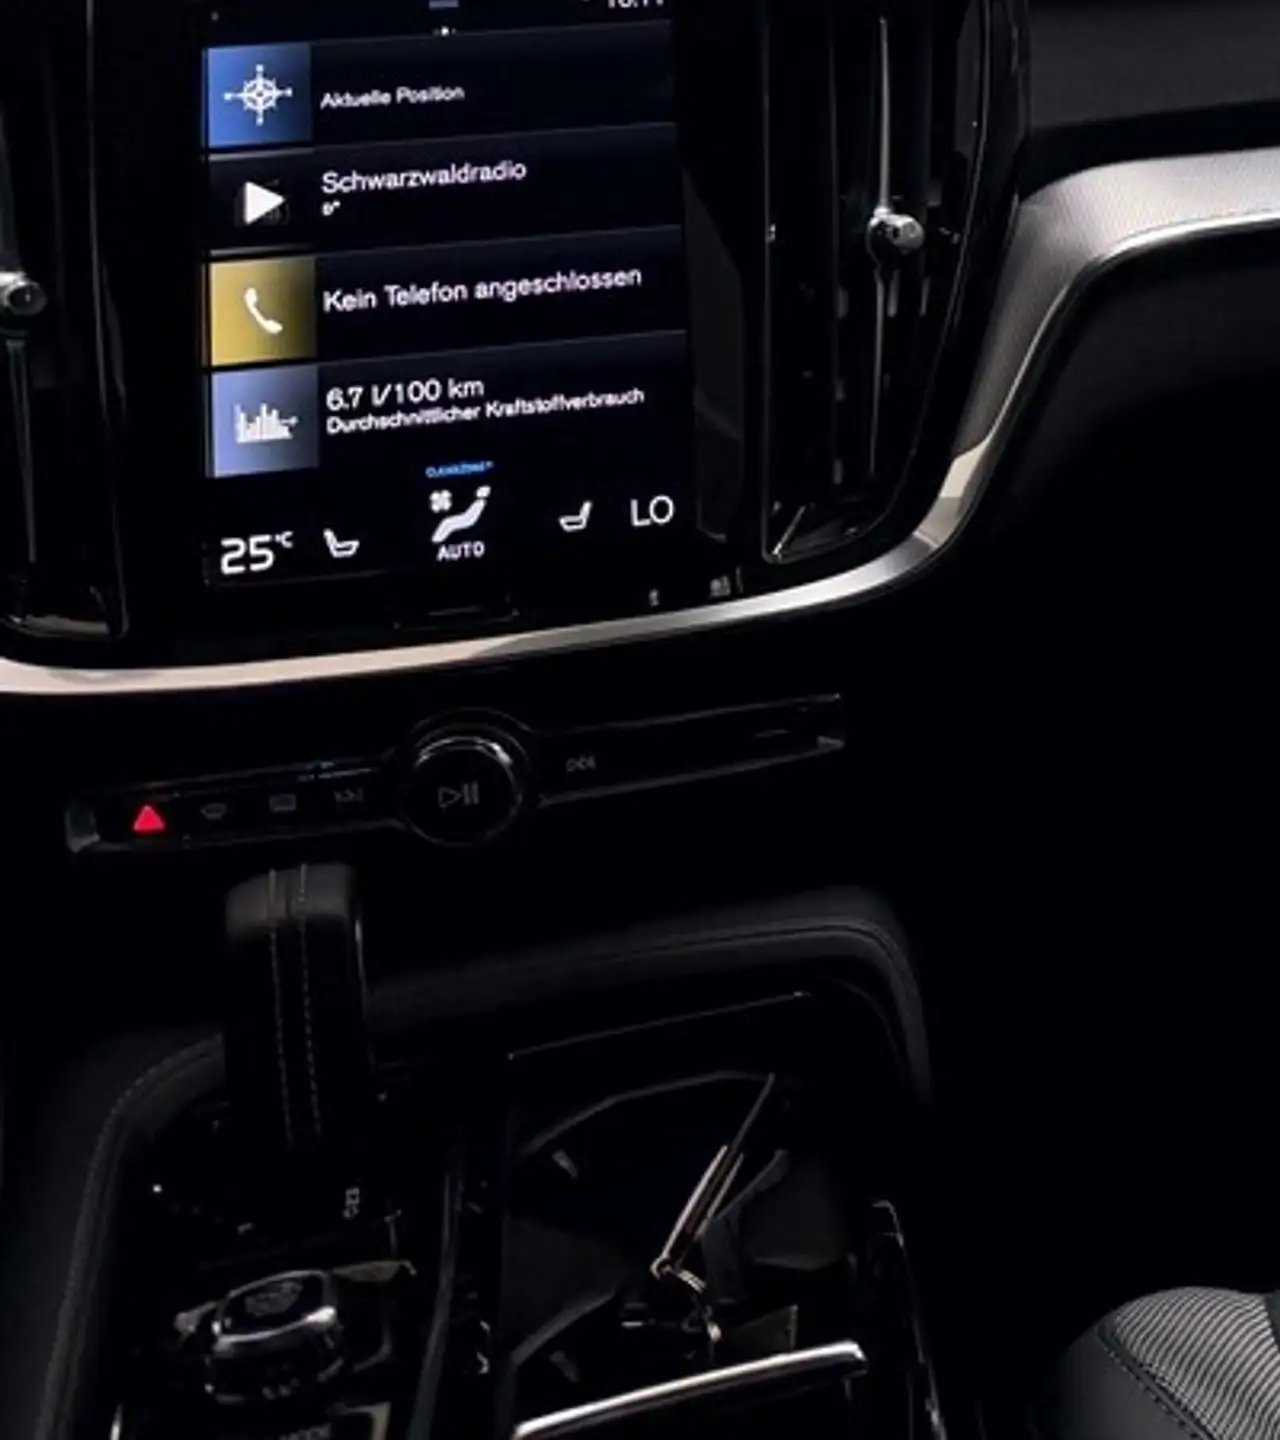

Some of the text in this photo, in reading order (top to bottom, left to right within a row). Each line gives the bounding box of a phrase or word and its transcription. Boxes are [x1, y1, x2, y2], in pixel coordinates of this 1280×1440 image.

[319, 85, 465, 110] Aktuelle Position
[322, 160, 527, 195] Schwarzwaldradio
[323, 267, 642, 312] Kein Telefon angeschlossen
[326, 386, 364, 412] 6.7
[447, 378, 485, 399] km
[326, 387, 645, 436] Durchschnittlicher Kraftstoffverbrauch
[630, 494, 675, 527] LO
[436, 540, 486, 562] AUTO
